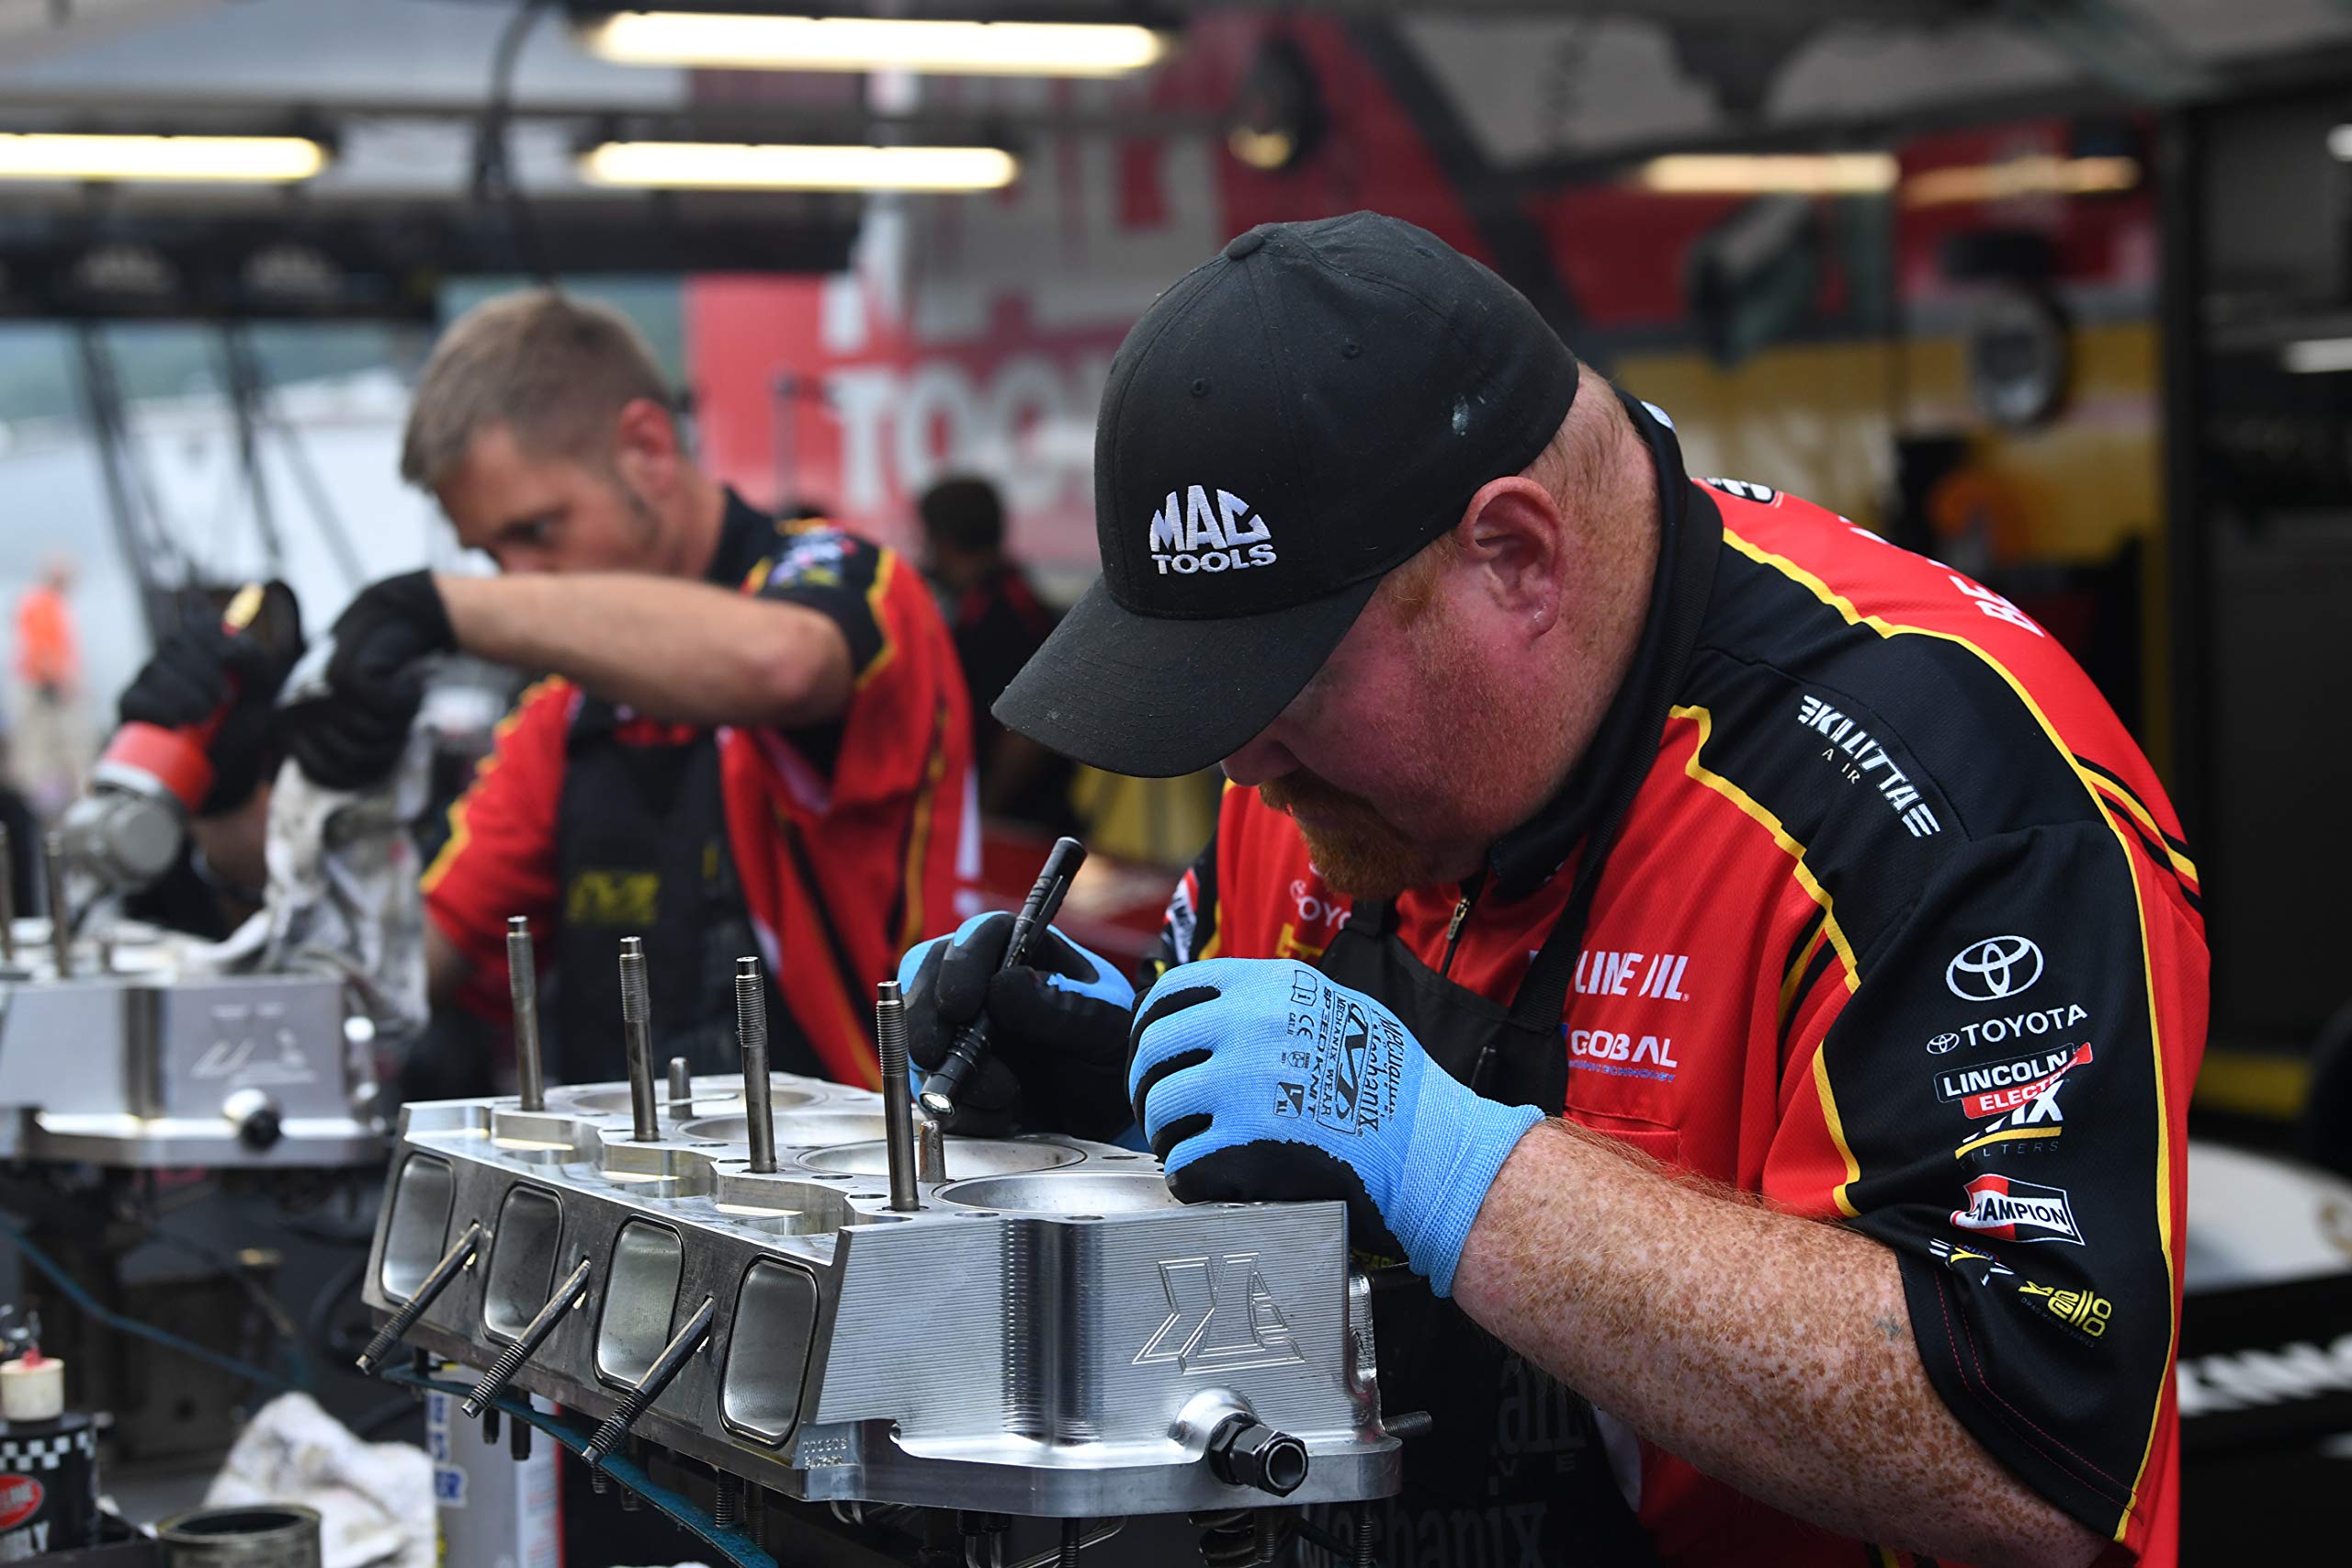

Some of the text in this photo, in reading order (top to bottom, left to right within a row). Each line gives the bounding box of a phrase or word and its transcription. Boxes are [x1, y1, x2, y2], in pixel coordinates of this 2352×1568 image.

[1149, 485, 1272, 552] MAC
[1151, 544, 1277, 574] TOOLS
[1822, 748, 1860, 784] AIR
[1961, 1003, 2088, 1047] TOYOTA
[1321, 996, 1347, 1117] MECHANIX WEAR
[1942, 1049, 2068, 1098] LINCOLN
[1306, 1055, 1325, 1119] KNIT
